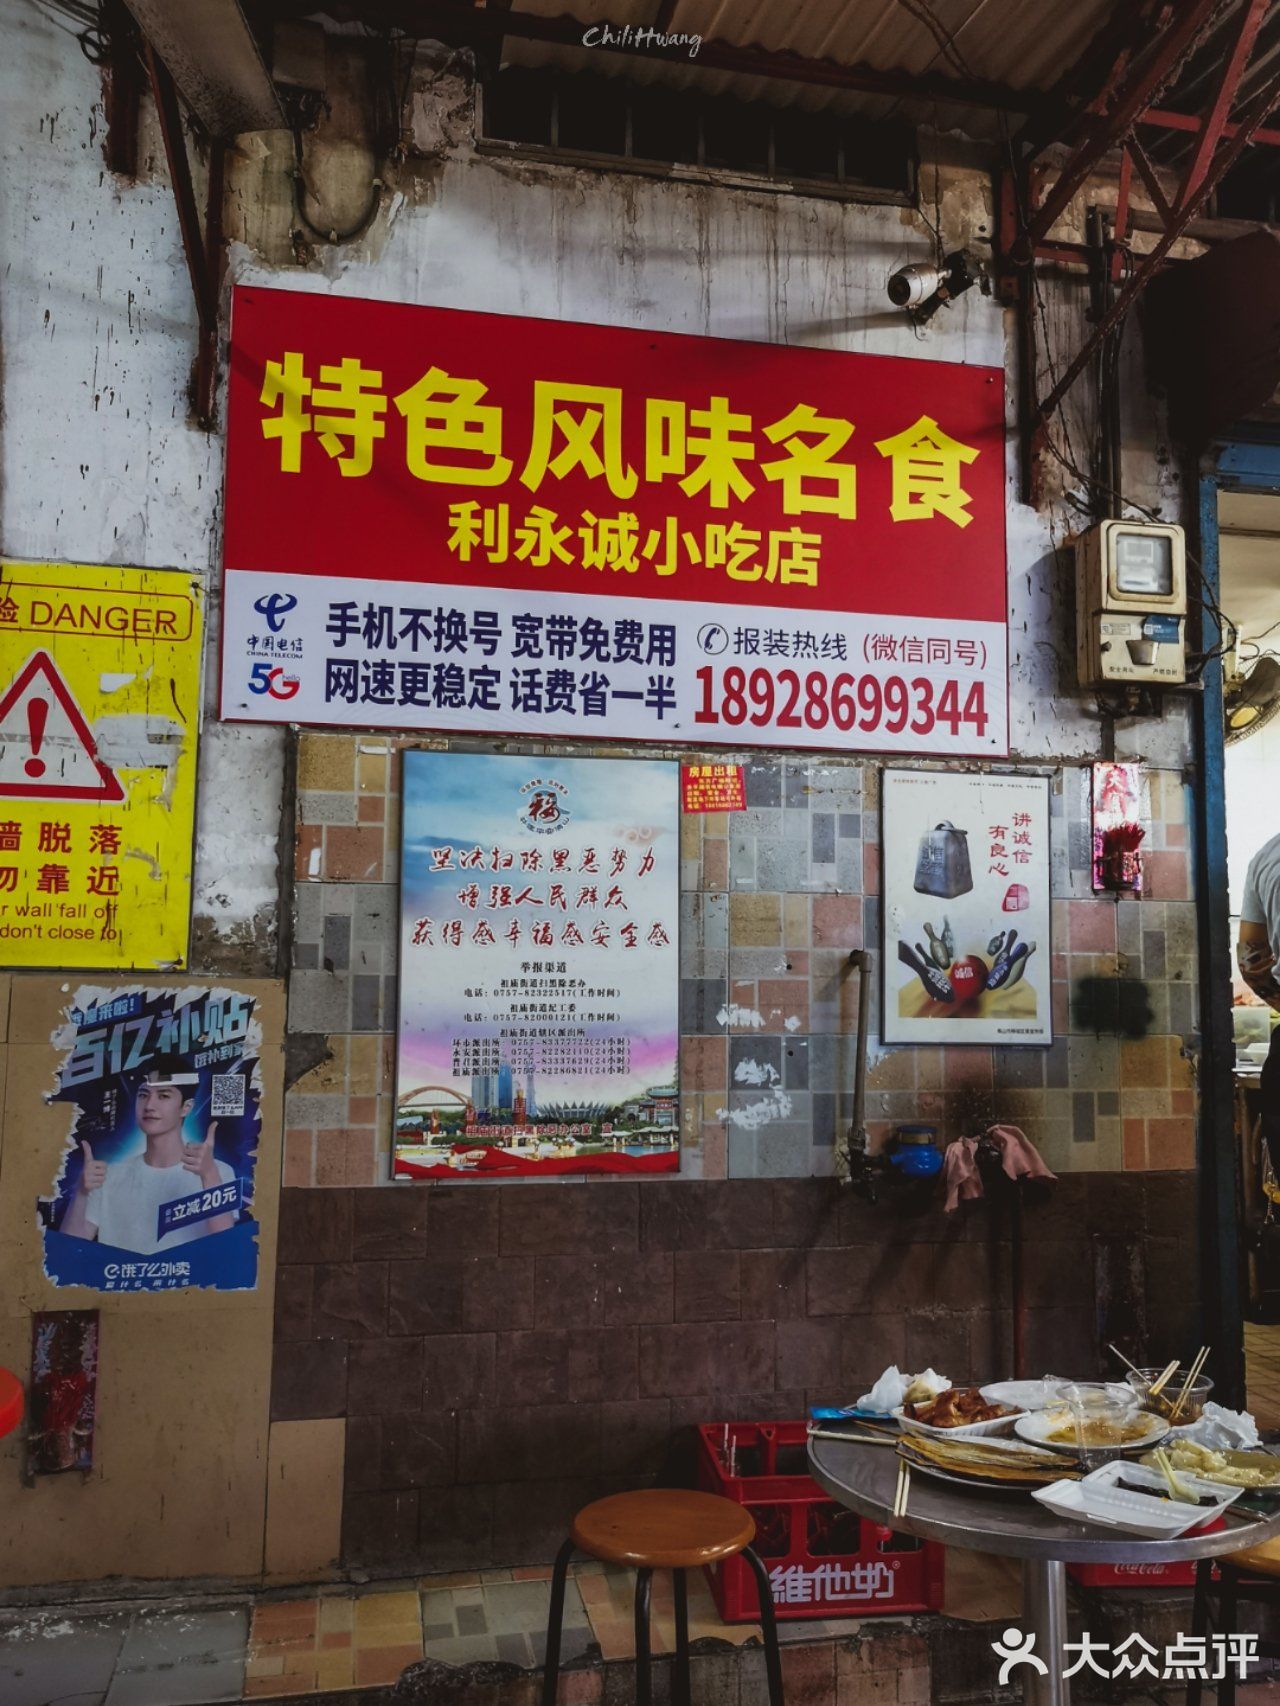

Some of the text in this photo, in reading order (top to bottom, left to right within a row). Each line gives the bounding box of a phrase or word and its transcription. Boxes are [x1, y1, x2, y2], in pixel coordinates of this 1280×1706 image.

[259, 351, 980, 529] 特色风味名食
[447, 500, 823, 587] 利永诚小吃店
[31, 601, 177, 635] DANGER
[325, 601, 677, 667] 手机不换号 宽带免费用
[246, 634, 304, 652] 中国电信
[270, 651, 303, 659] TELECOM
[733, 626, 848, 661] 报装热线
[248, 662, 300, 700] 5G
[325, 658, 677, 720] 网速更稳定 话费省一半
[695, 665, 988, 737] 18928699344
[988, 824, 1010, 877] 有良心
[1012, 812, 1033, 864] 讲诚信
[431, 846, 656, 877] 坚决扫除黑恶势力
[15, 903, 52, 917] wall
[60, 903, 87, 918] fall
[95, 903, 118, 918] off
[458, 884, 628, 911] 增强人民群众
[0, 923, 42, 939] don't
[48, 925, 94, 940] close
[411, 917, 671, 949] 获得感幸福感安全感
[520, 961, 567, 974] 举报渠道
[61, 994, 249, 1088] 百亿补贴
[172, 1186, 237, 1221] 立减20元
[121, 1262, 190, 1278] 饿了么外卖
[769, 1562, 894, 1604] 維他奶
